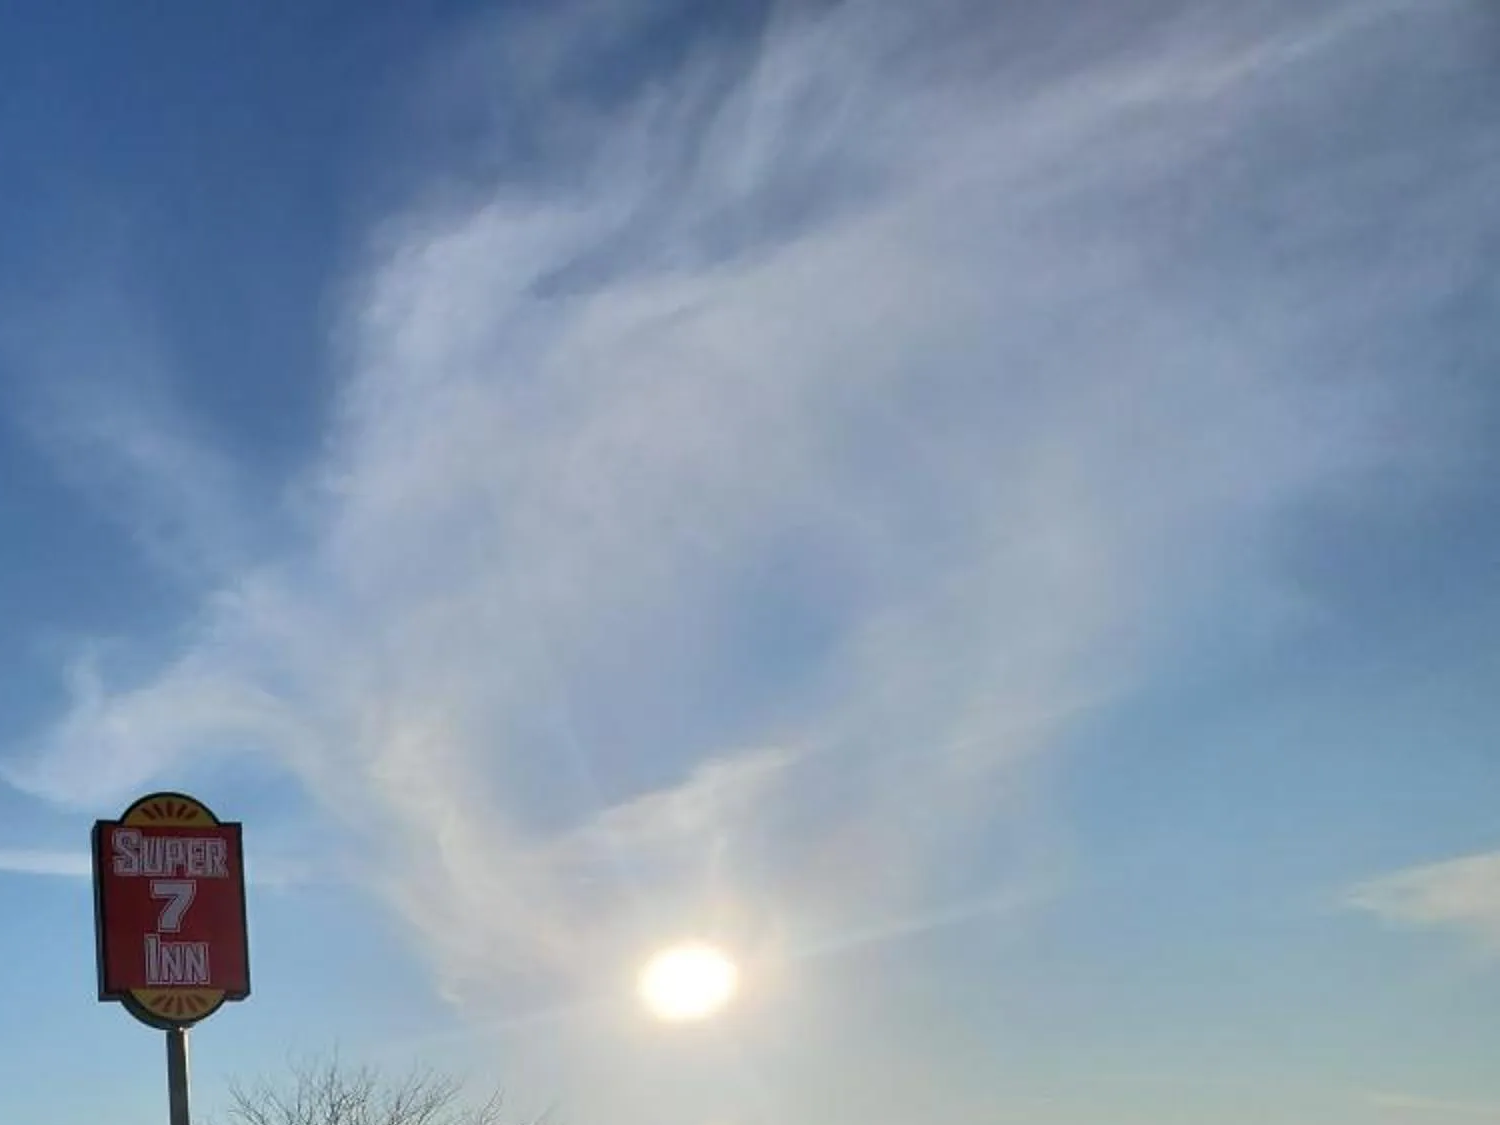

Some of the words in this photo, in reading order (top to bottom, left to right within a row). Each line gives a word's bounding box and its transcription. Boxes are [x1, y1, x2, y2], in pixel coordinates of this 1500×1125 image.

[112, 828, 229, 878] SUPER
[150, 879, 196, 933] 7
[144, 932, 211, 985] INN
